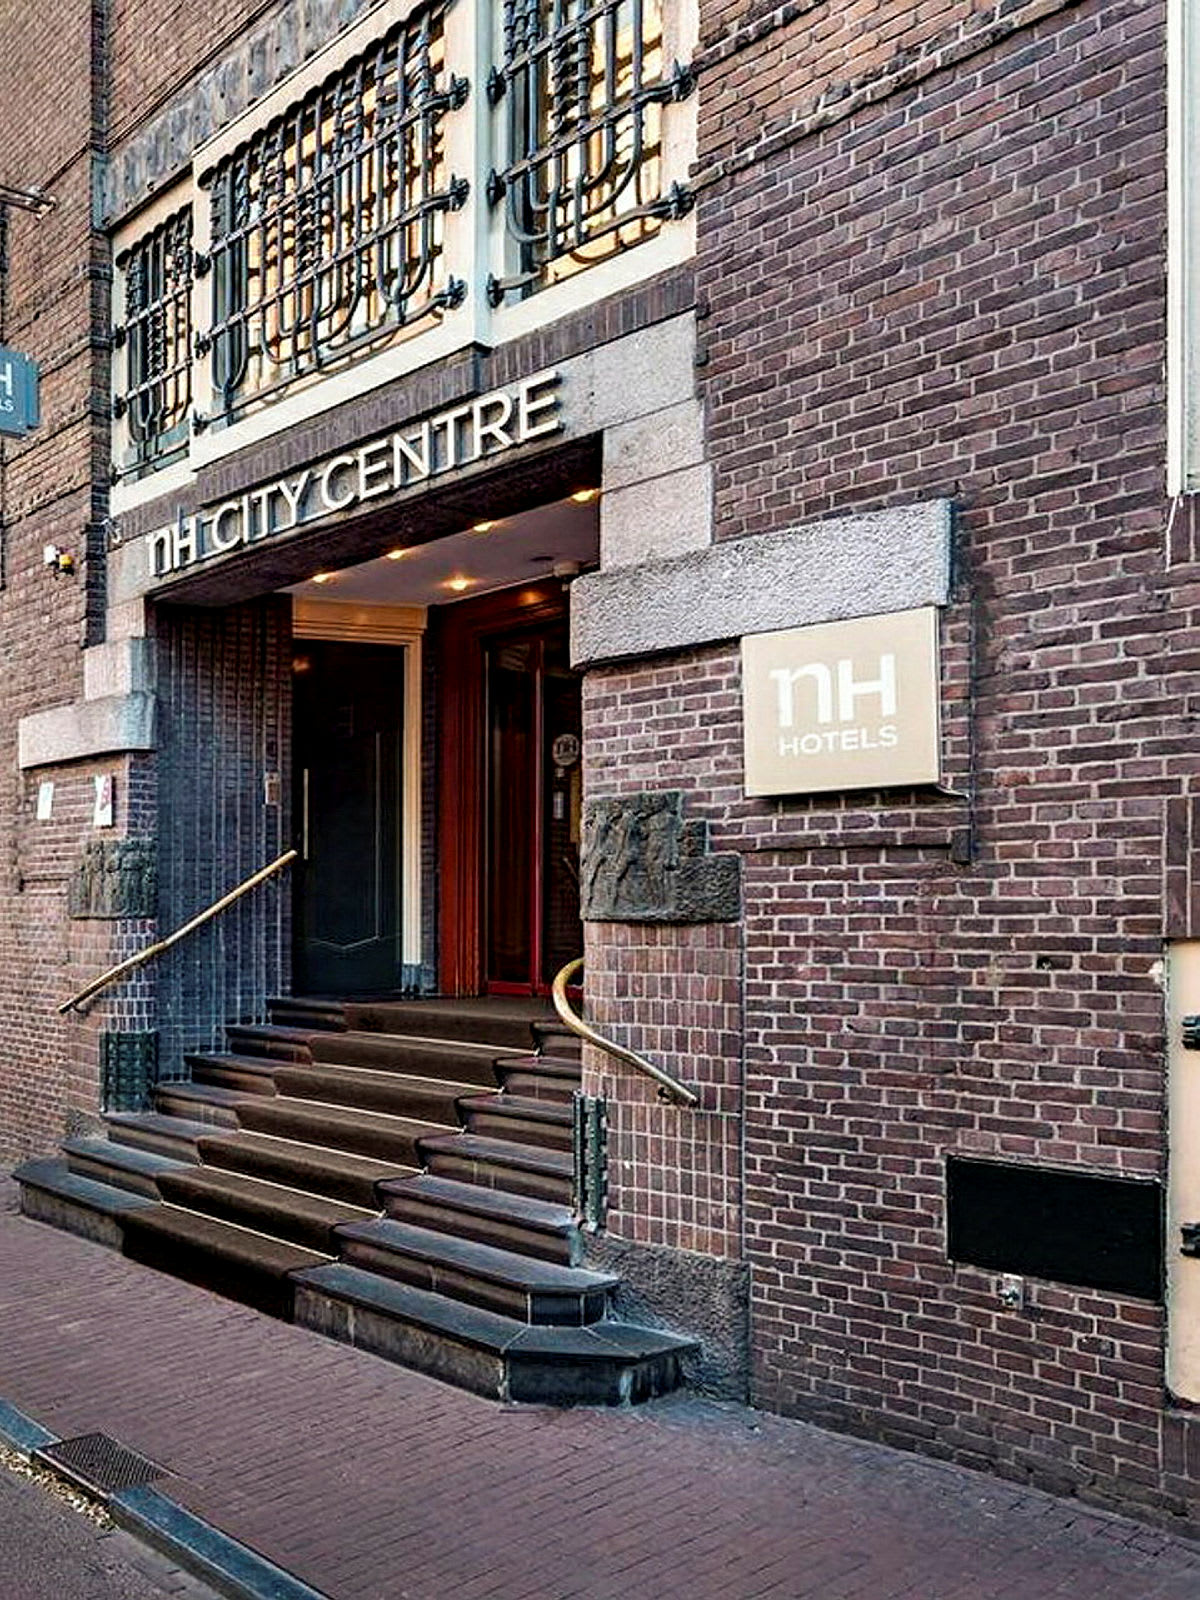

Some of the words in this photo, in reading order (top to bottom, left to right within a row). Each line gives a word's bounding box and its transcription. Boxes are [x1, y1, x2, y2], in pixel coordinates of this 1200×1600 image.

[211, 470, 310, 552] CITY
[320, 370, 561, 511] CENTRE
[779, 725, 898, 757] HOTELS
